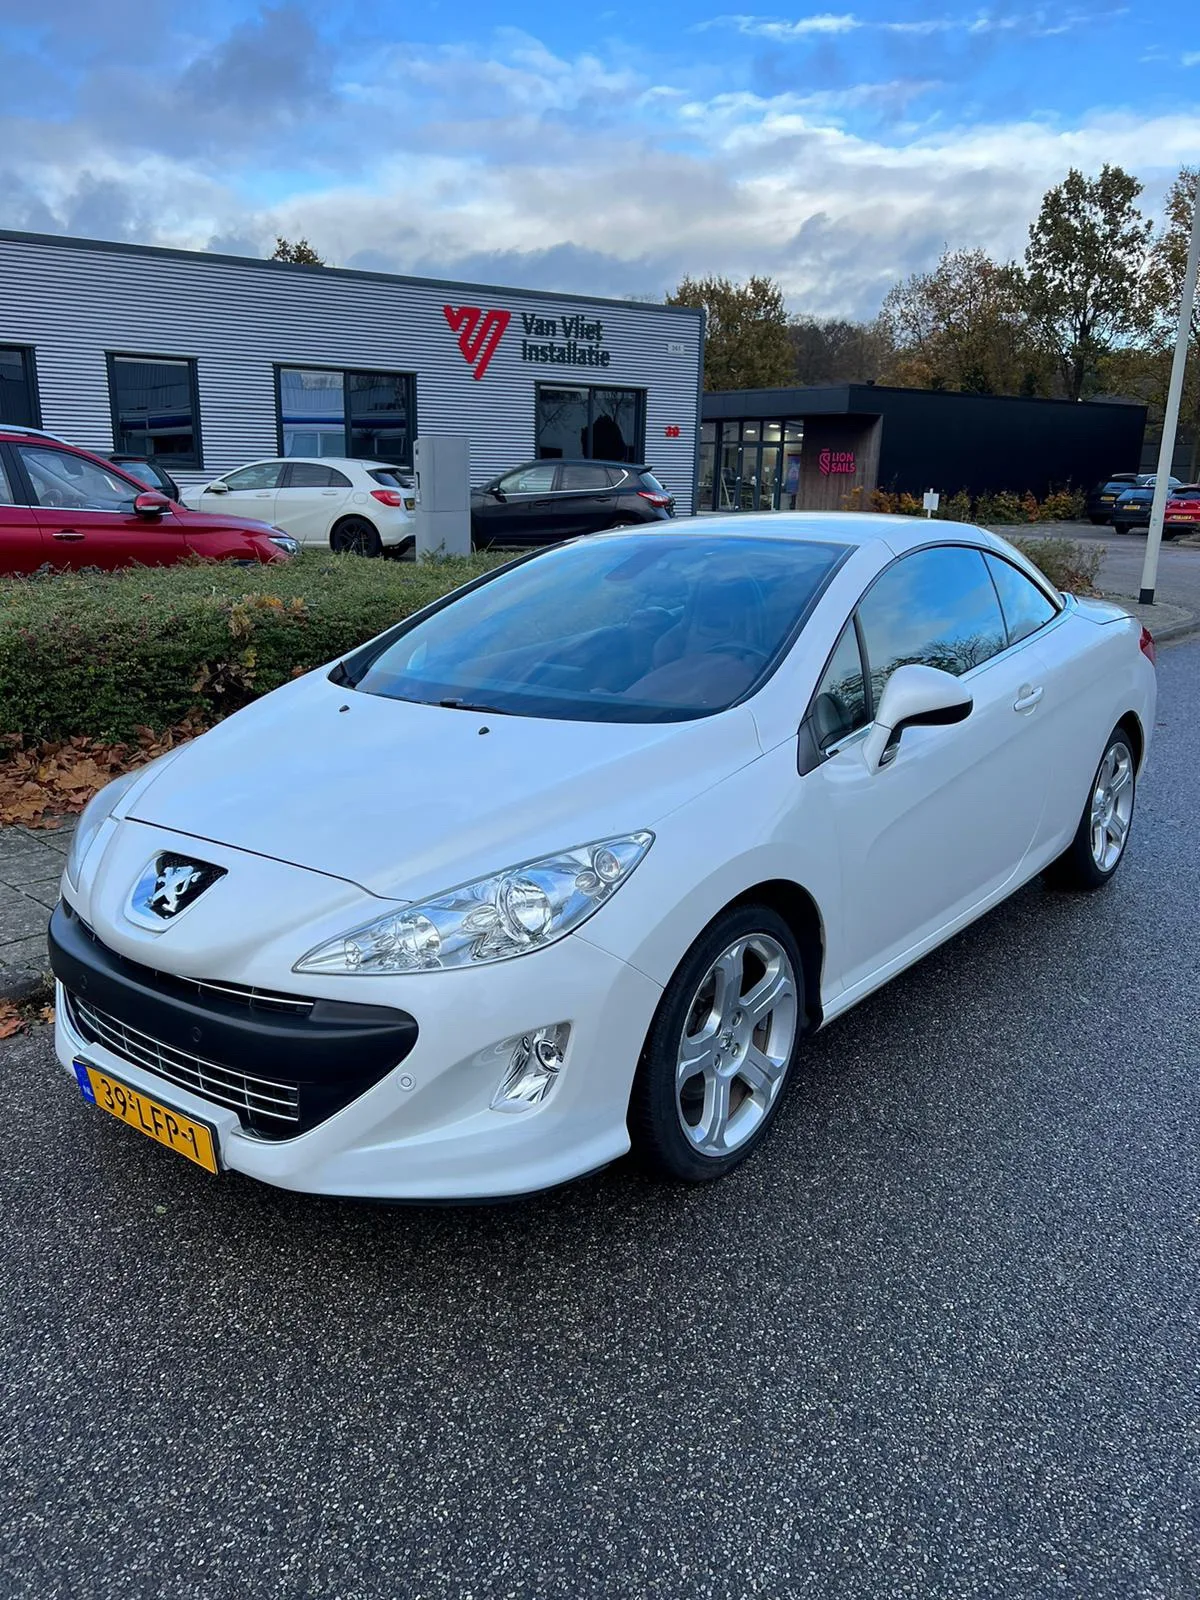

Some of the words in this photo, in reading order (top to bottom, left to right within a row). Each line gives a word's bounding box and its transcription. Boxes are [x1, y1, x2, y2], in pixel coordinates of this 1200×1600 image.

[521, 312, 556, 337] Van
[560, 314, 603, 341] Vliet
[521, 339, 610, 367] Installatie
[831, 462, 856, 473] SAILS
[832, 452, 854, 462] LION
[101, 1078, 200, 1159] 39-LFP-1
